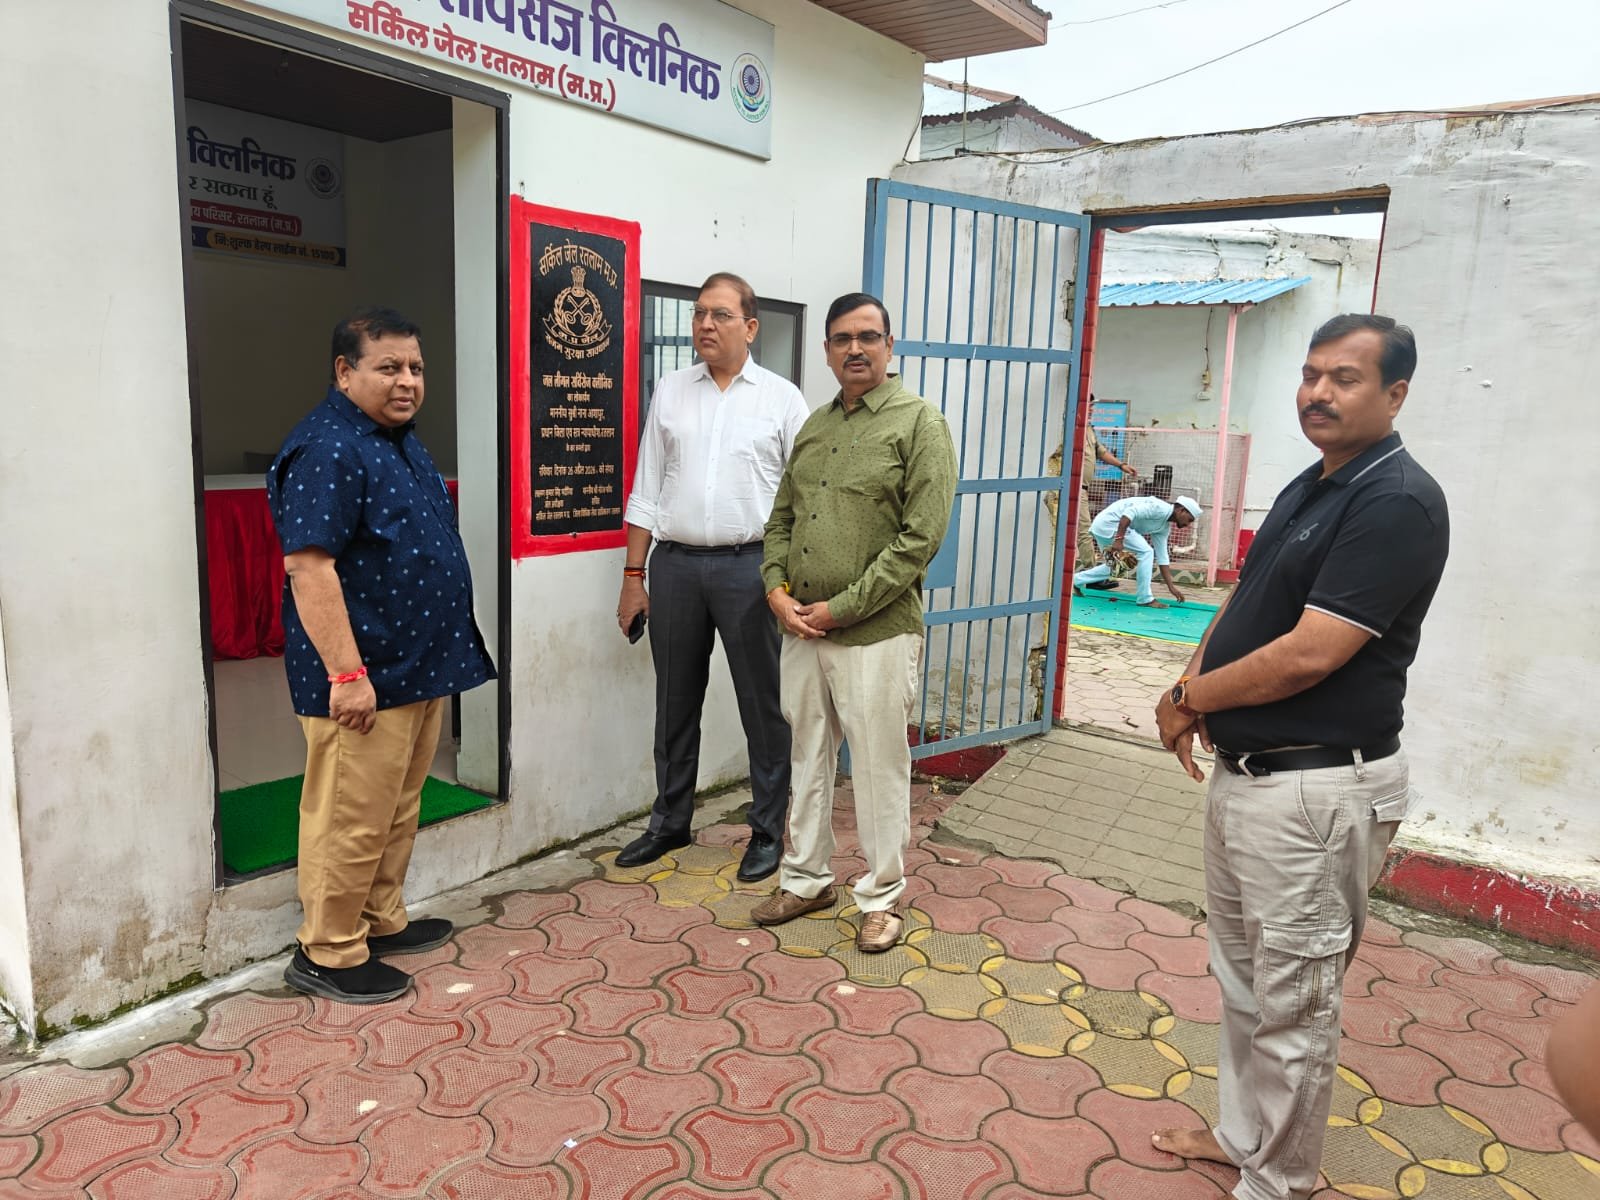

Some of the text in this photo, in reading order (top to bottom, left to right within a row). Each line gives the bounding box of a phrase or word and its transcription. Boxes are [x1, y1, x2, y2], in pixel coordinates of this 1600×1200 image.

[347, 1, 617, 112] सर्किल जेल रतलाम (म.प्र.)
[589, 0, 722, 100] क्लिनिक
[187, 125, 297, 180] क्लिनिक
[202, 178, 259, 201] सकता
[237, 212, 269, 229] रतलाम
[539, 243, 562, 277] सर्किल
[563, 238, 578, 265] जेल
[579, 246, 604, 276] रतलाम
